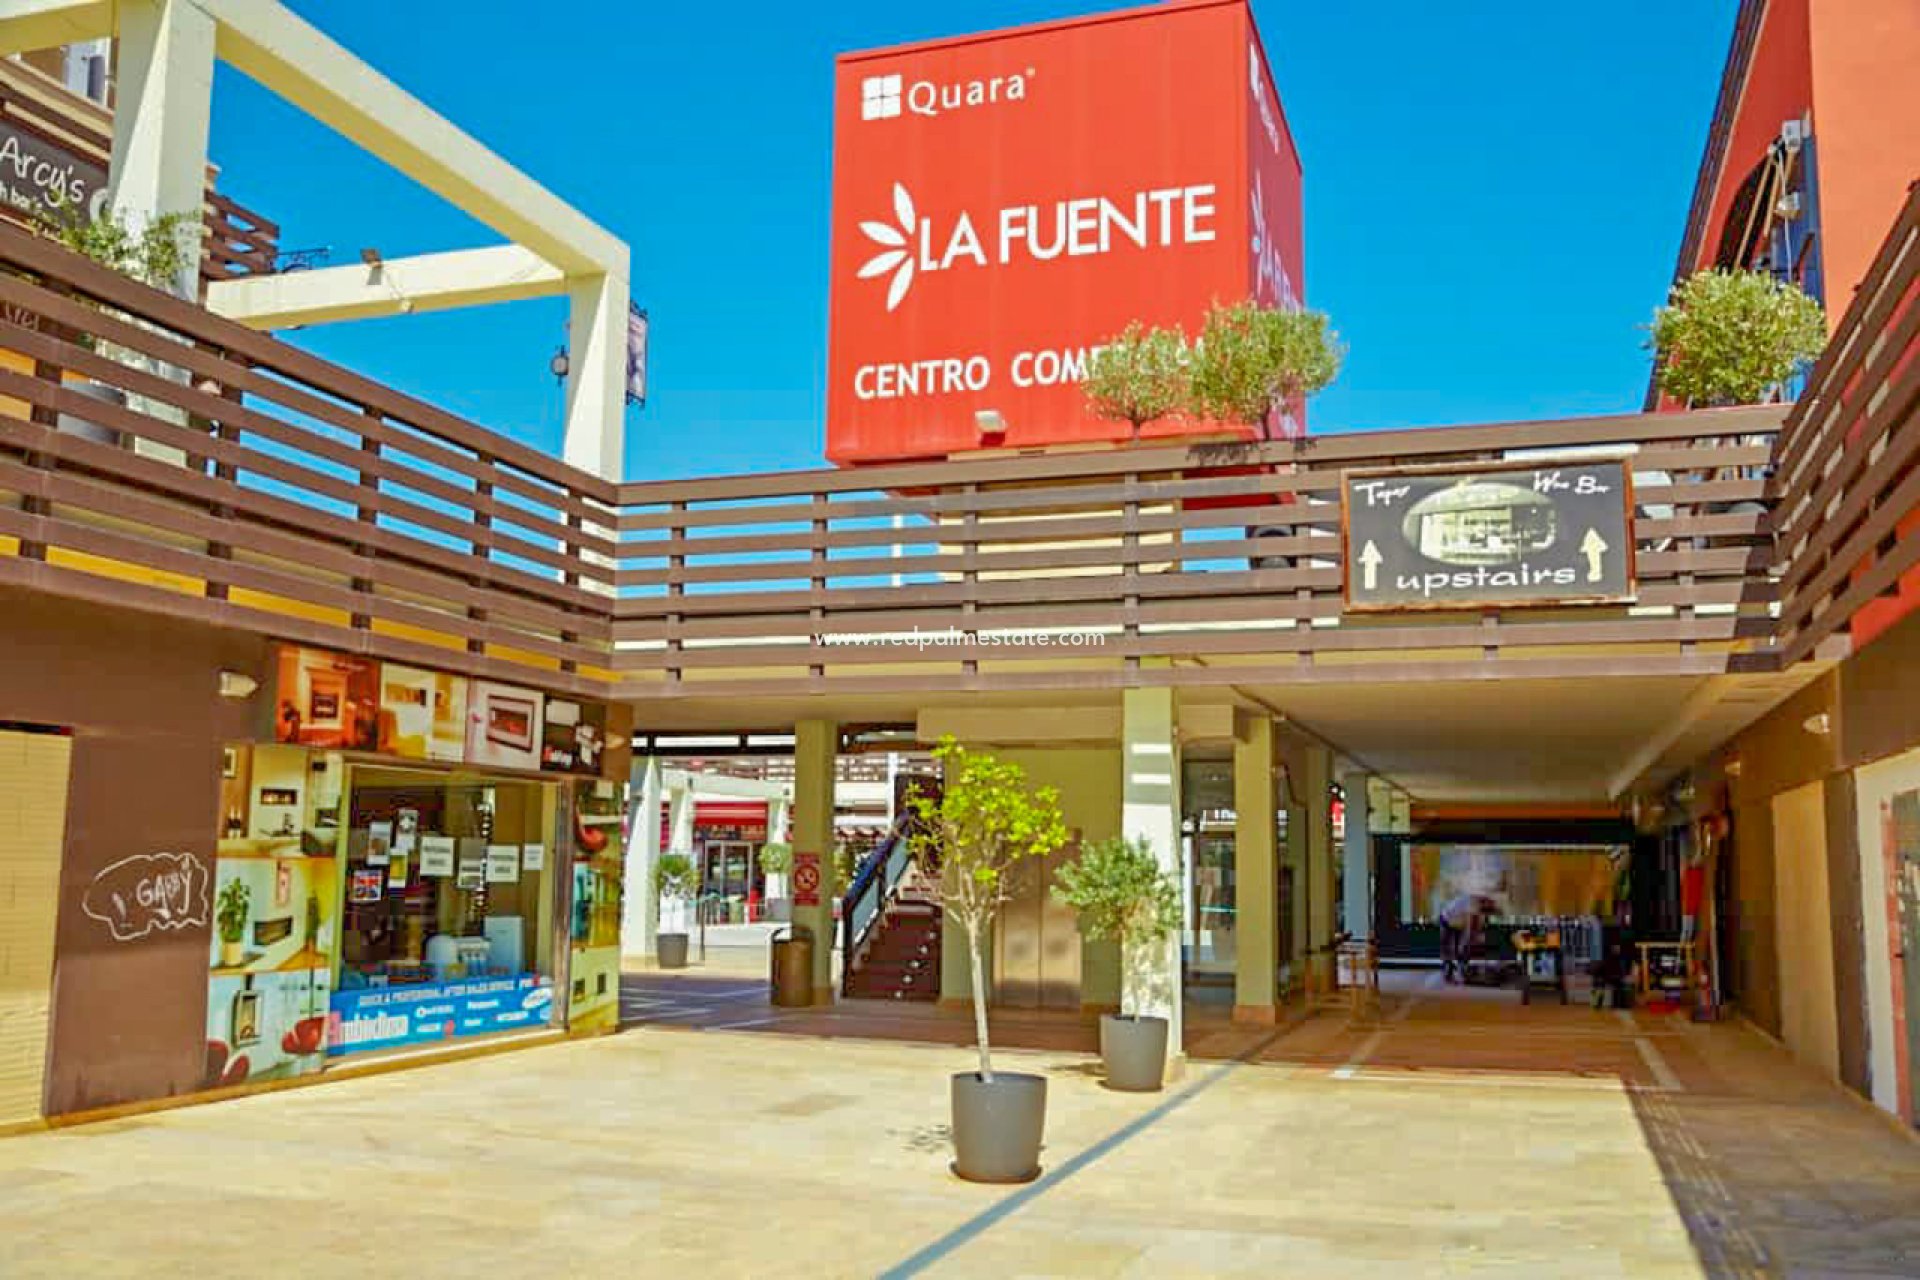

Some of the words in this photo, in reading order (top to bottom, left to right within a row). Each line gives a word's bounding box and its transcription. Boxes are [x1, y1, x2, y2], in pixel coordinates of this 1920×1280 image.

[908, 73, 1025, 116] Quara
[0, 136, 85, 208] Arcy's
[919, 210, 988, 272] LA
[999, 184, 1216, 264] FUENTE
[853, 356, 991, 400] CENTRO
[1396, 563, 1576, 597] upstairs
